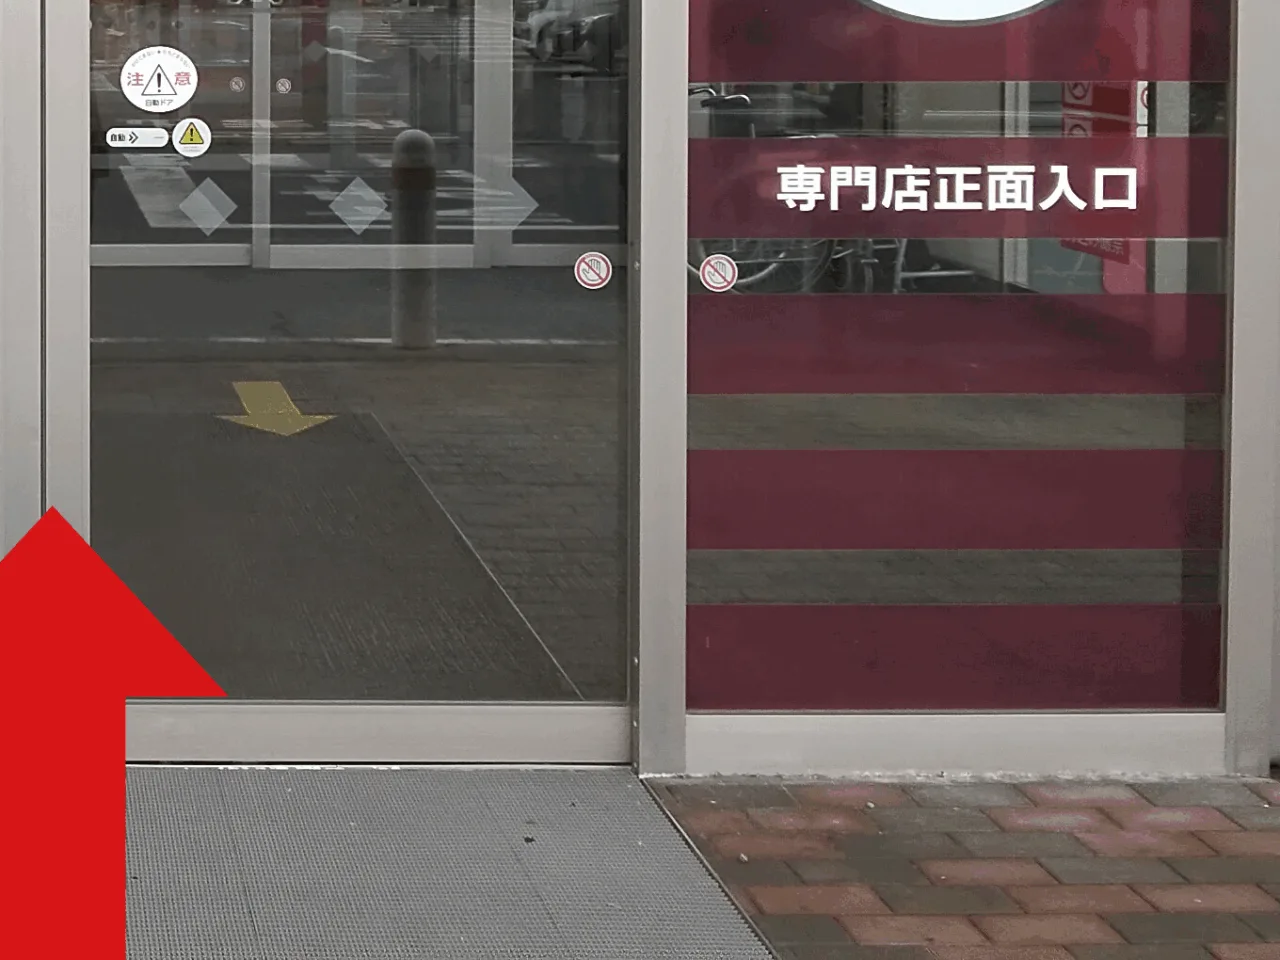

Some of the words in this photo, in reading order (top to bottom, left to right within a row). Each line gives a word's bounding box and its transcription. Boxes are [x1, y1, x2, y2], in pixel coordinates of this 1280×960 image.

[145, 99, 174, 107] 自動ドア
[110, 133, 125, 142] 自動
[776, 164, 1137, 212] 専門店正面入口
